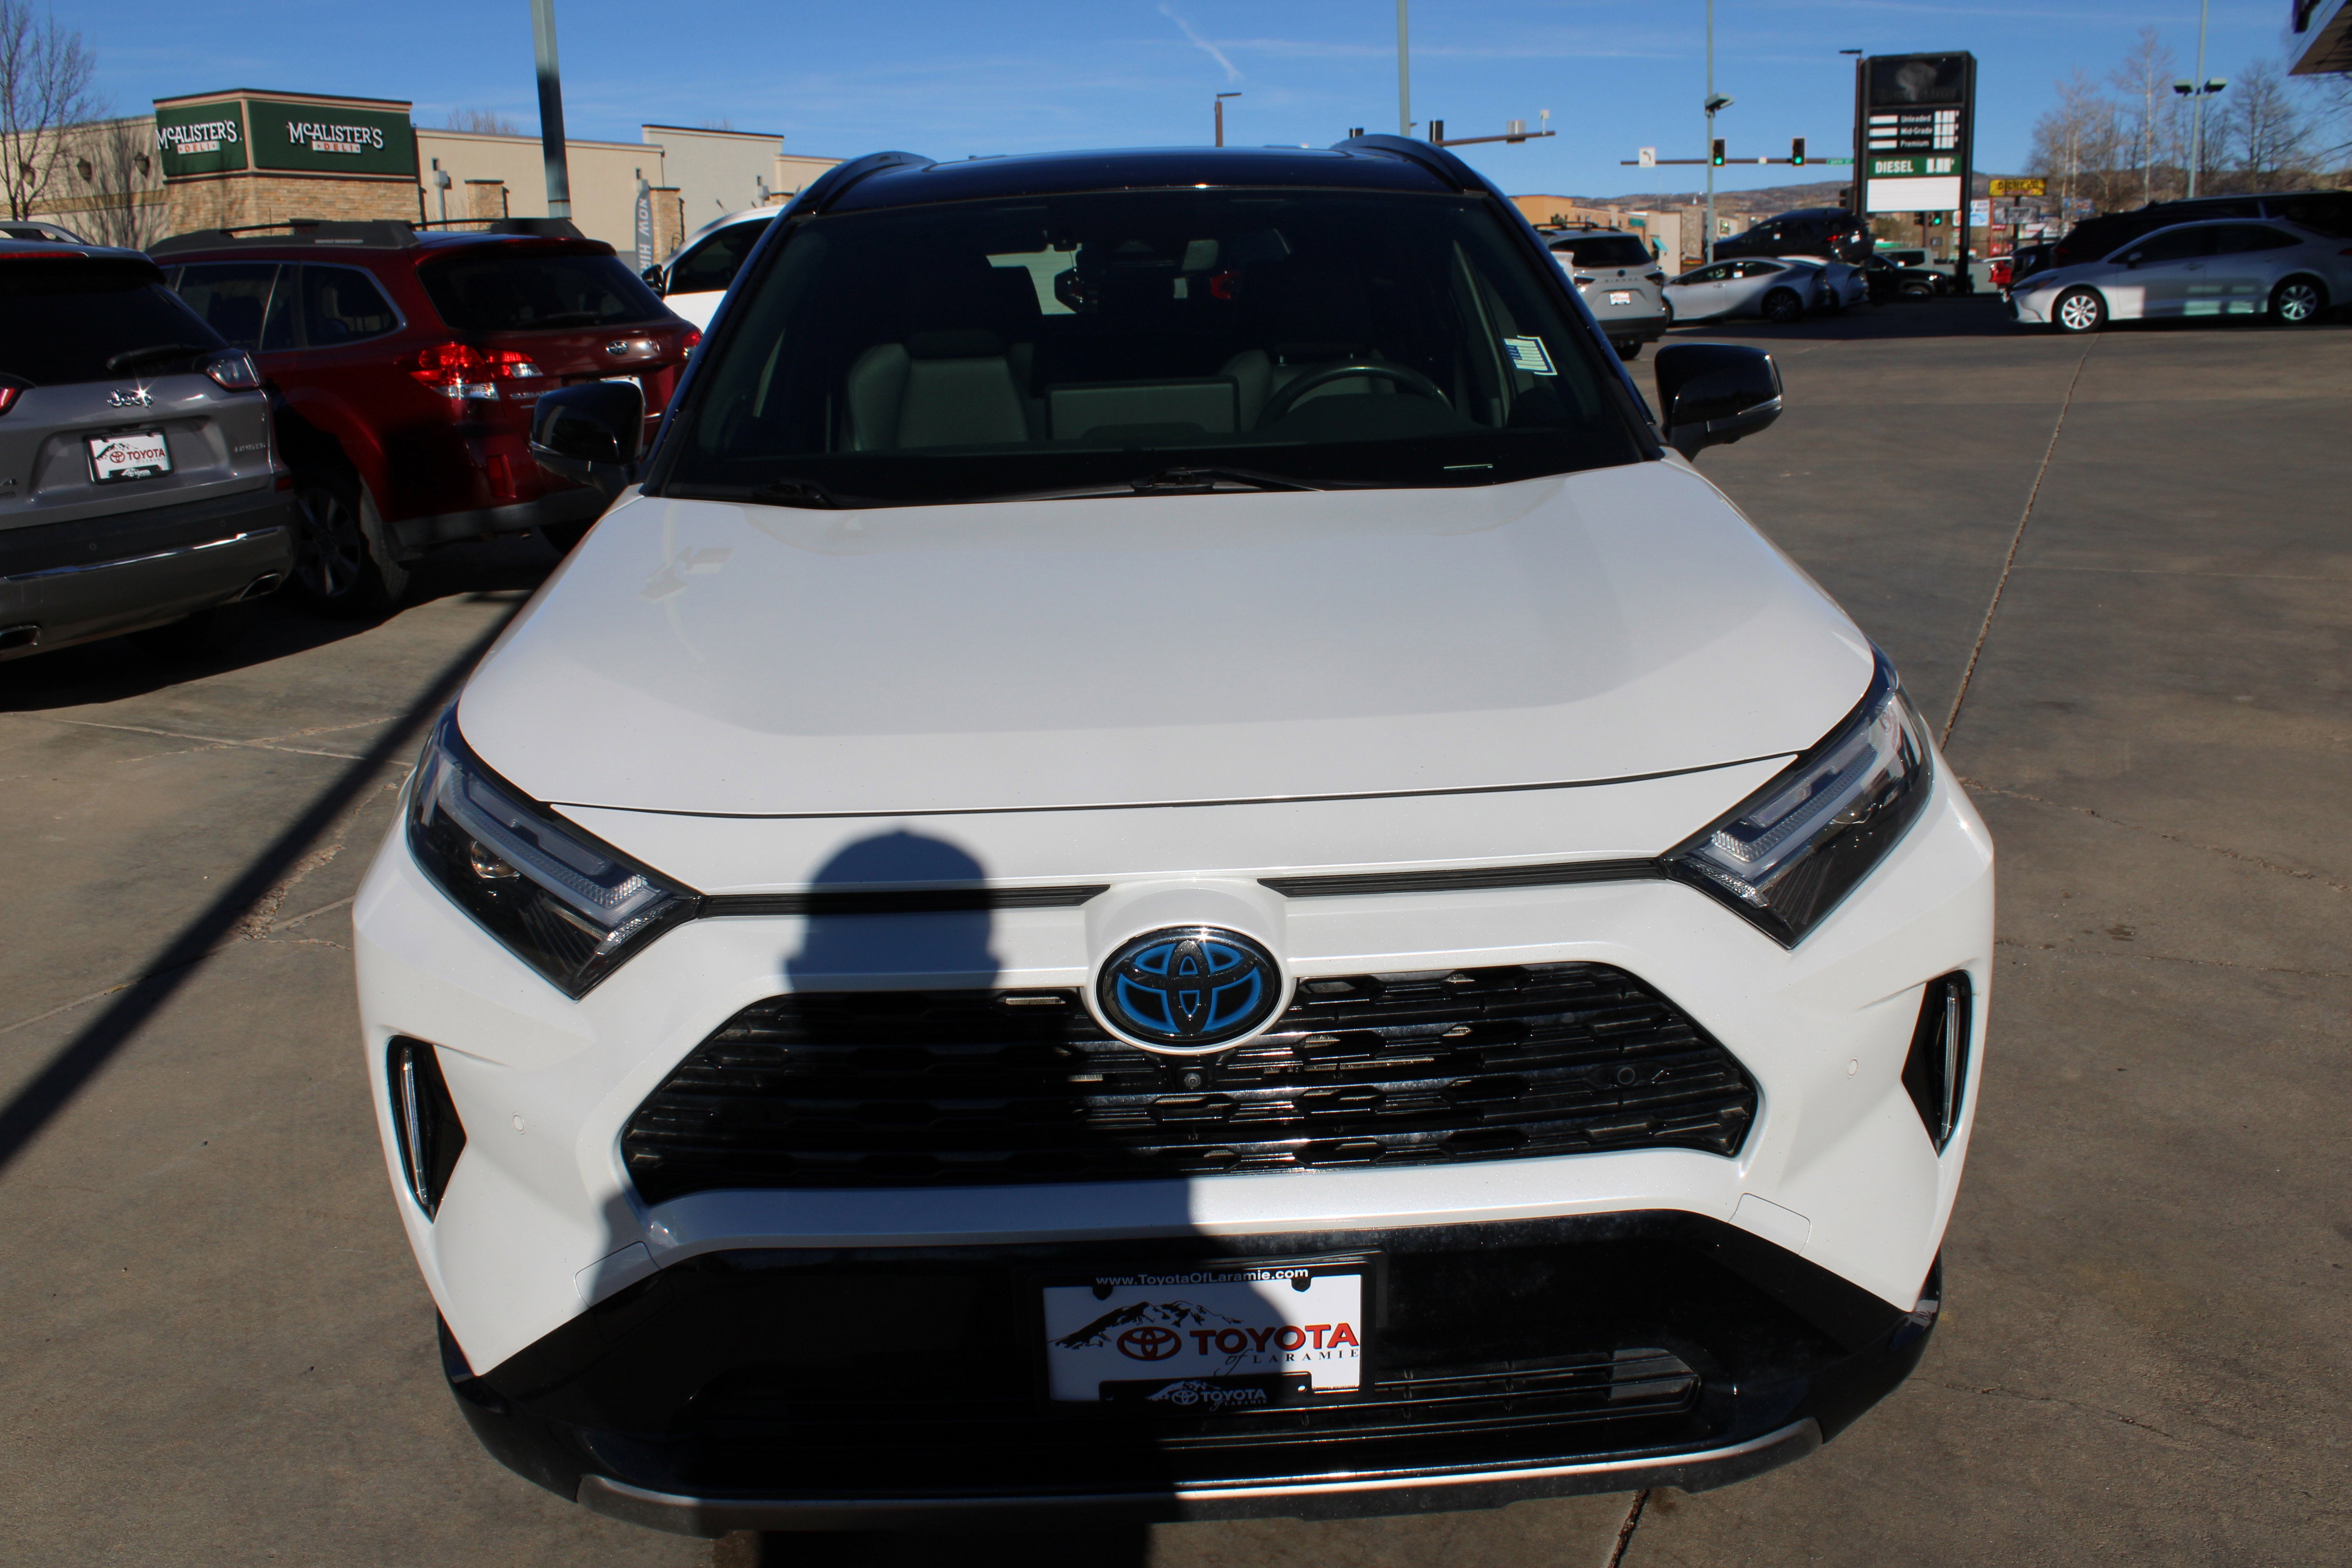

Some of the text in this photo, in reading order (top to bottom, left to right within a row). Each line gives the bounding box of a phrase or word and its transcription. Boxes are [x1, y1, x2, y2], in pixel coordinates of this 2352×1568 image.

[1901, 114, 1931, 123] Unleaded
[1901, 127, 1933, 135] Mid-Grade
[185, 143, 210, 153] DELI
[324, 143, 353, 151] DELI
[1900, 140, 1929, 148] Premium
[1875, 160, 1913, 173] DIESEL
[639, 198, 650, 237] NOW
[107, 389, 153, 408] Jeep
[127, 449, 165, 460] TOYOTA
[1096, 1268, 1308, 1285] www.ToyotaOfLaramie.com
[1189, 1323, 1359, 1355] TOYOTA
[1214, 1348, 1359, 1377] of LARAMIE
[1200, 1389, 1266, 1402] TOYOTA
